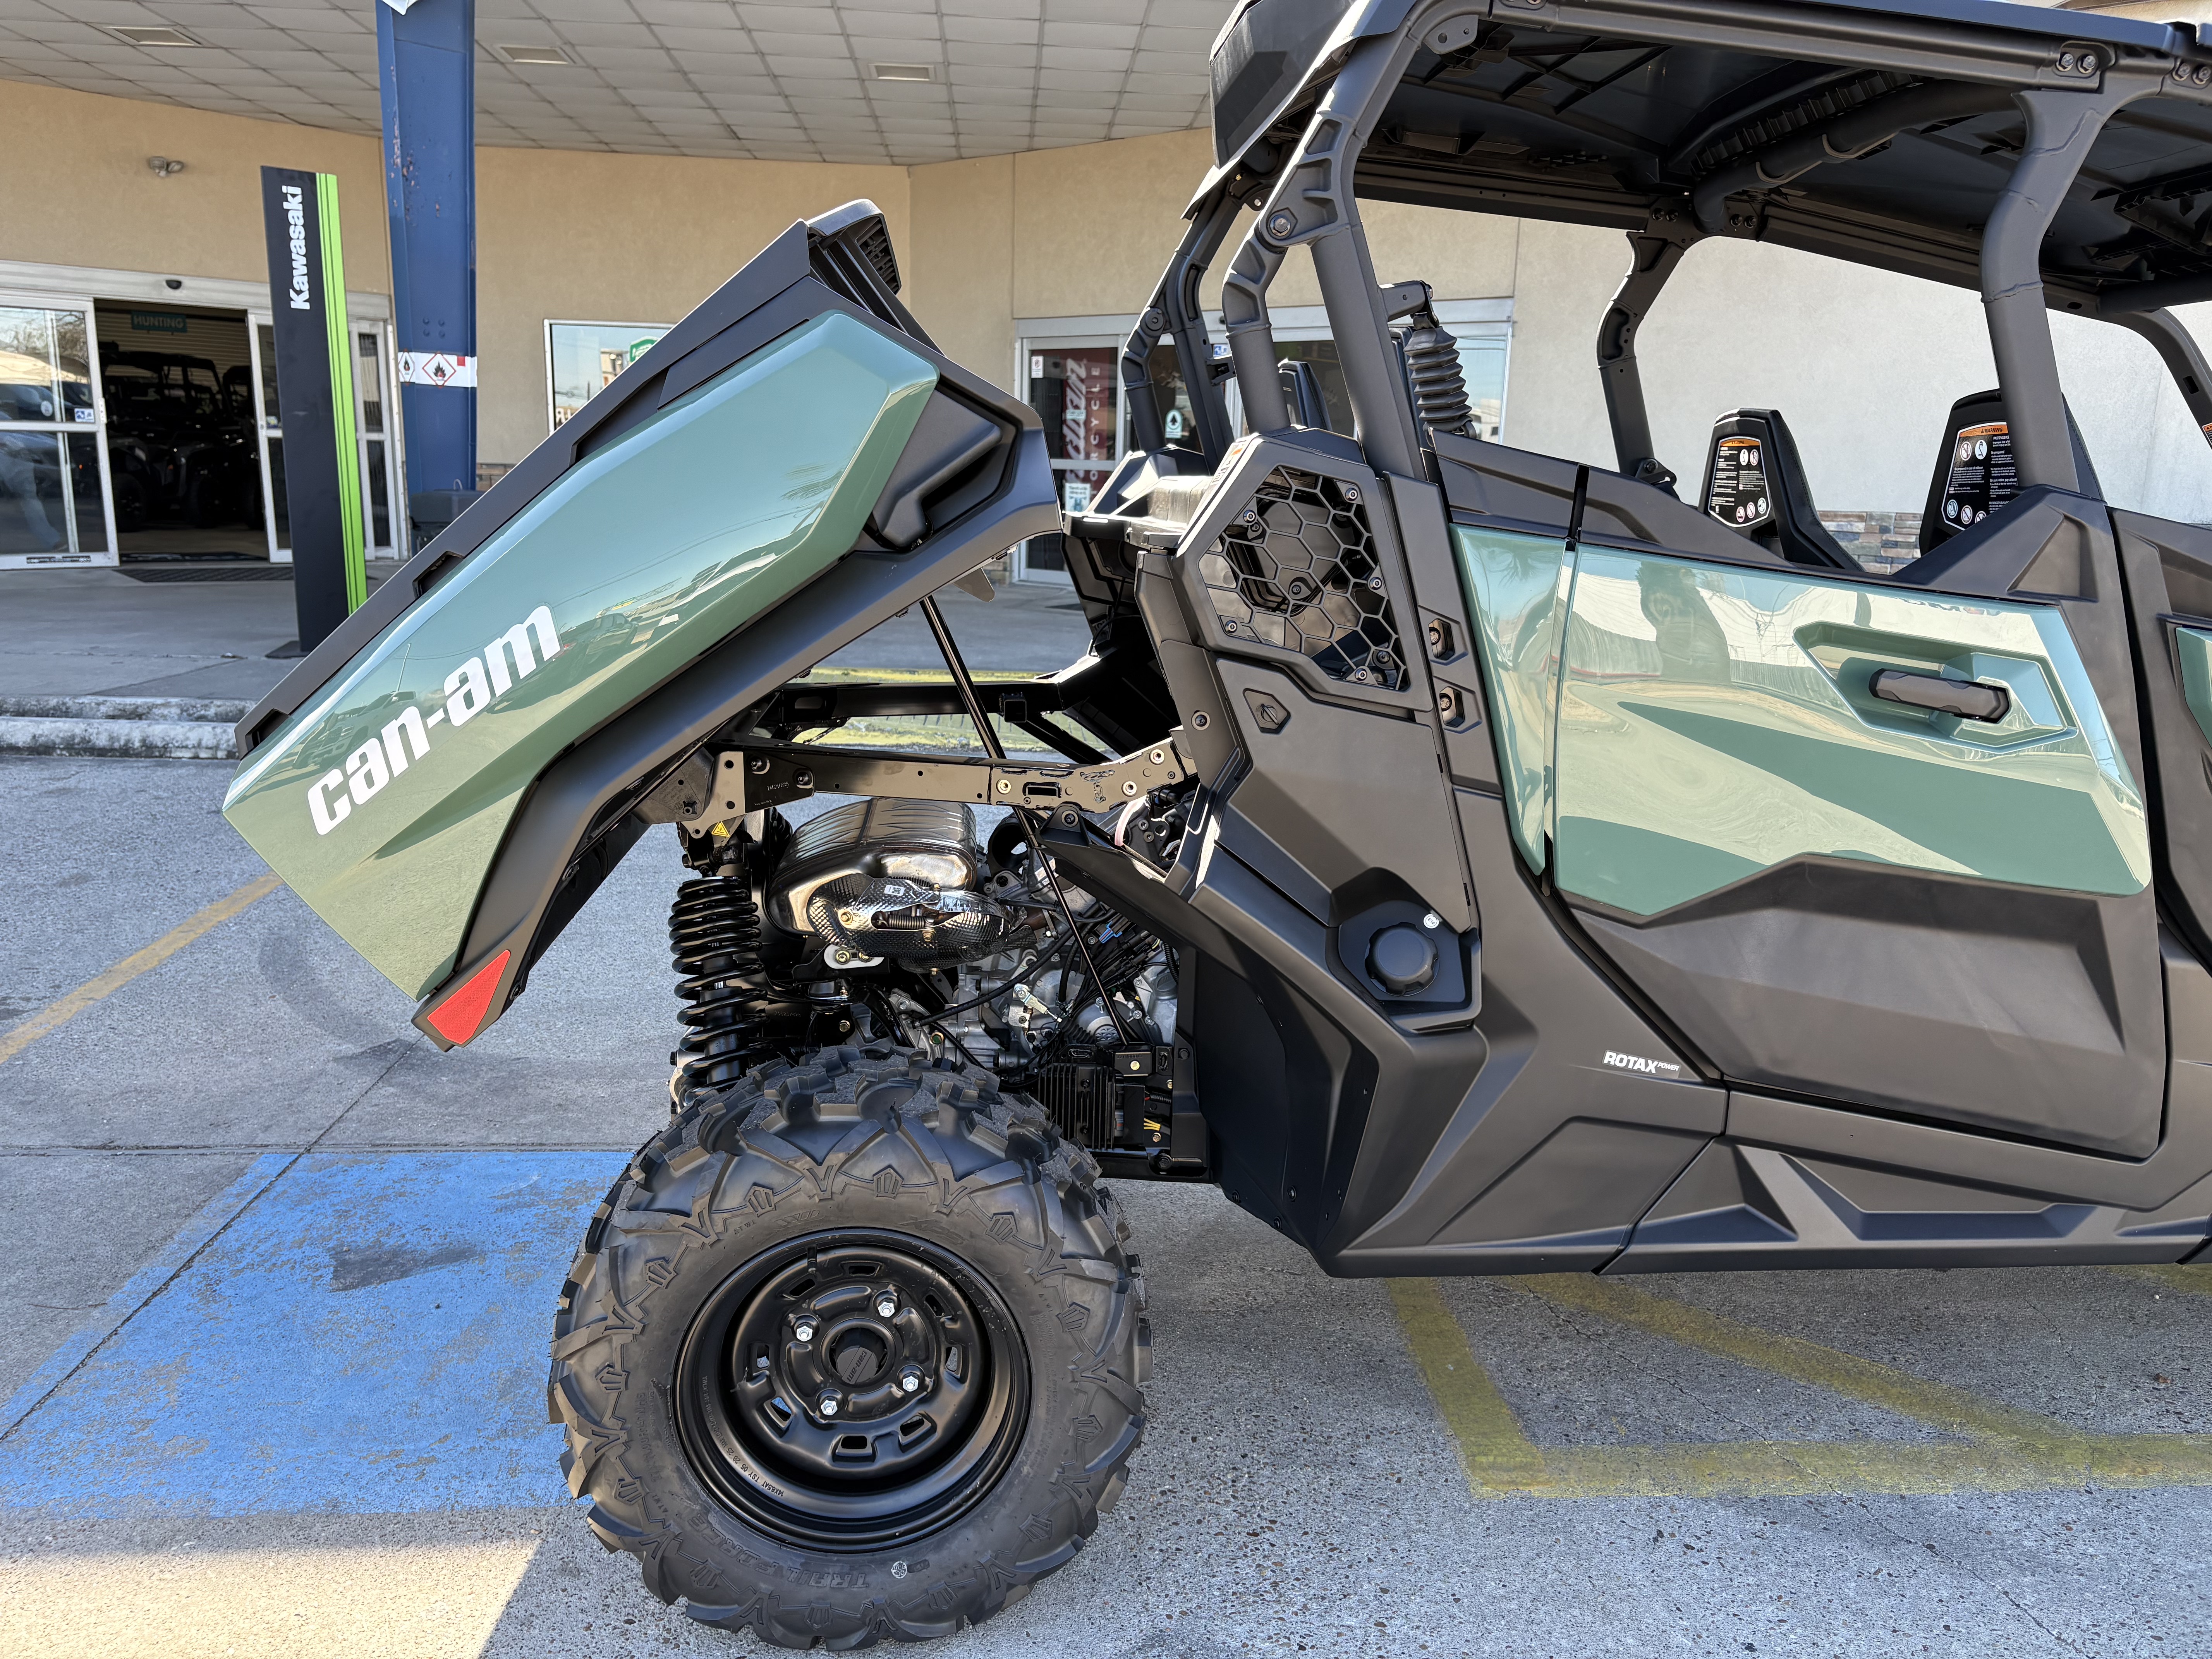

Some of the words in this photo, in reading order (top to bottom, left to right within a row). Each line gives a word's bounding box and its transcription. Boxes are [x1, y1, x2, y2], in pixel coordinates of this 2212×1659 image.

[282, 185, 310, 310] Kawasaki
[133, 315, 184, 328] HUNTING
[307, 605, 561, 835] can-am
[1603, 1051, 1659, 1073] ROTAX
[1657, 1061, 1680, 1071] POWER
[847, 1351, 867, 1382] can-am
[726, 1447, 734, 1455] 25
[732, 1455, 741, 1464] 26
[739, 1463, 749, 1472] 05
[747, 1470, 761, 1482] TSY
[686, 1511, 780, 1577] FORCE
[783, 1565, 868, 1589] TRAIL
